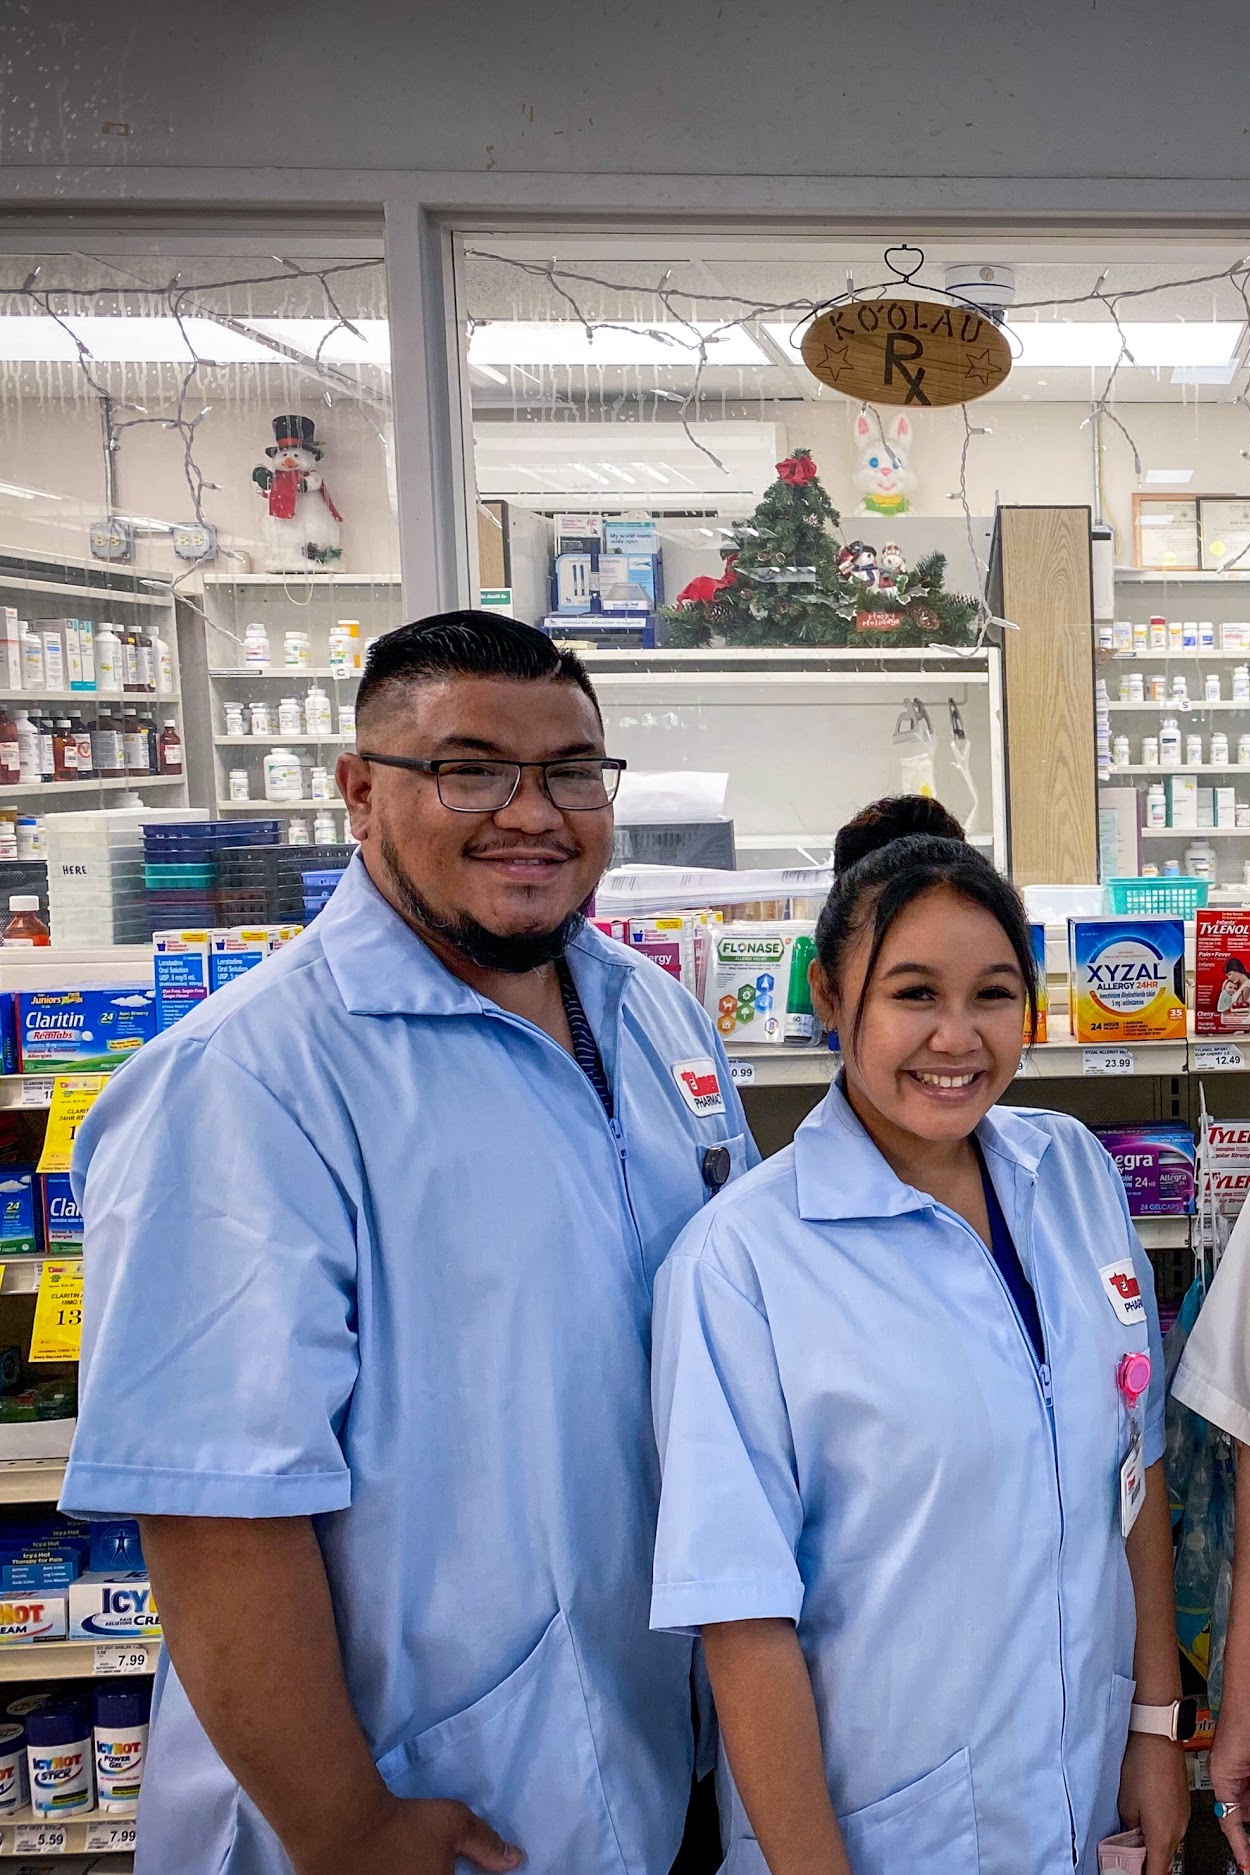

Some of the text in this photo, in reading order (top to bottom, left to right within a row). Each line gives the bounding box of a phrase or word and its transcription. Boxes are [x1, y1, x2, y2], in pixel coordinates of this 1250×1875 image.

[62, 865, 87, 876] HERE
[1199, 922, 1249, 934] TYLENOL
[723, 942, 779, 953] FLONASE
[1087, 963, 1167, 983] XYZAL
[1097, 981, 1158, 990] ALLERGY 24HR
[1170, 1008, 1182, 1016] 35
[25, 1011, 84, 1028] Claritin
[33, 1031, 73, 1039] RediTabs
[1105, 1059, 1130, 1067] 23.99
[1215, 1056, 1240, 1064] 12.49
[1114, 1154, 1153, 1170] egra
[1135, 1177, 1148, 1187] 24
[1160, 1174, 1187, 1182] Allegra
[102, 1588, 156, 1614] ICY
[0, 1604, 45, 1625] HOT
[134, 1615, 161, 1625] CRE
[119, 1655, 145, 1666] 7.99
[40, 1768, 72, 1781] STICK
[38, 1834, 63, 1845] 5.59
[110, 1831, 136, 1842] 7.99
